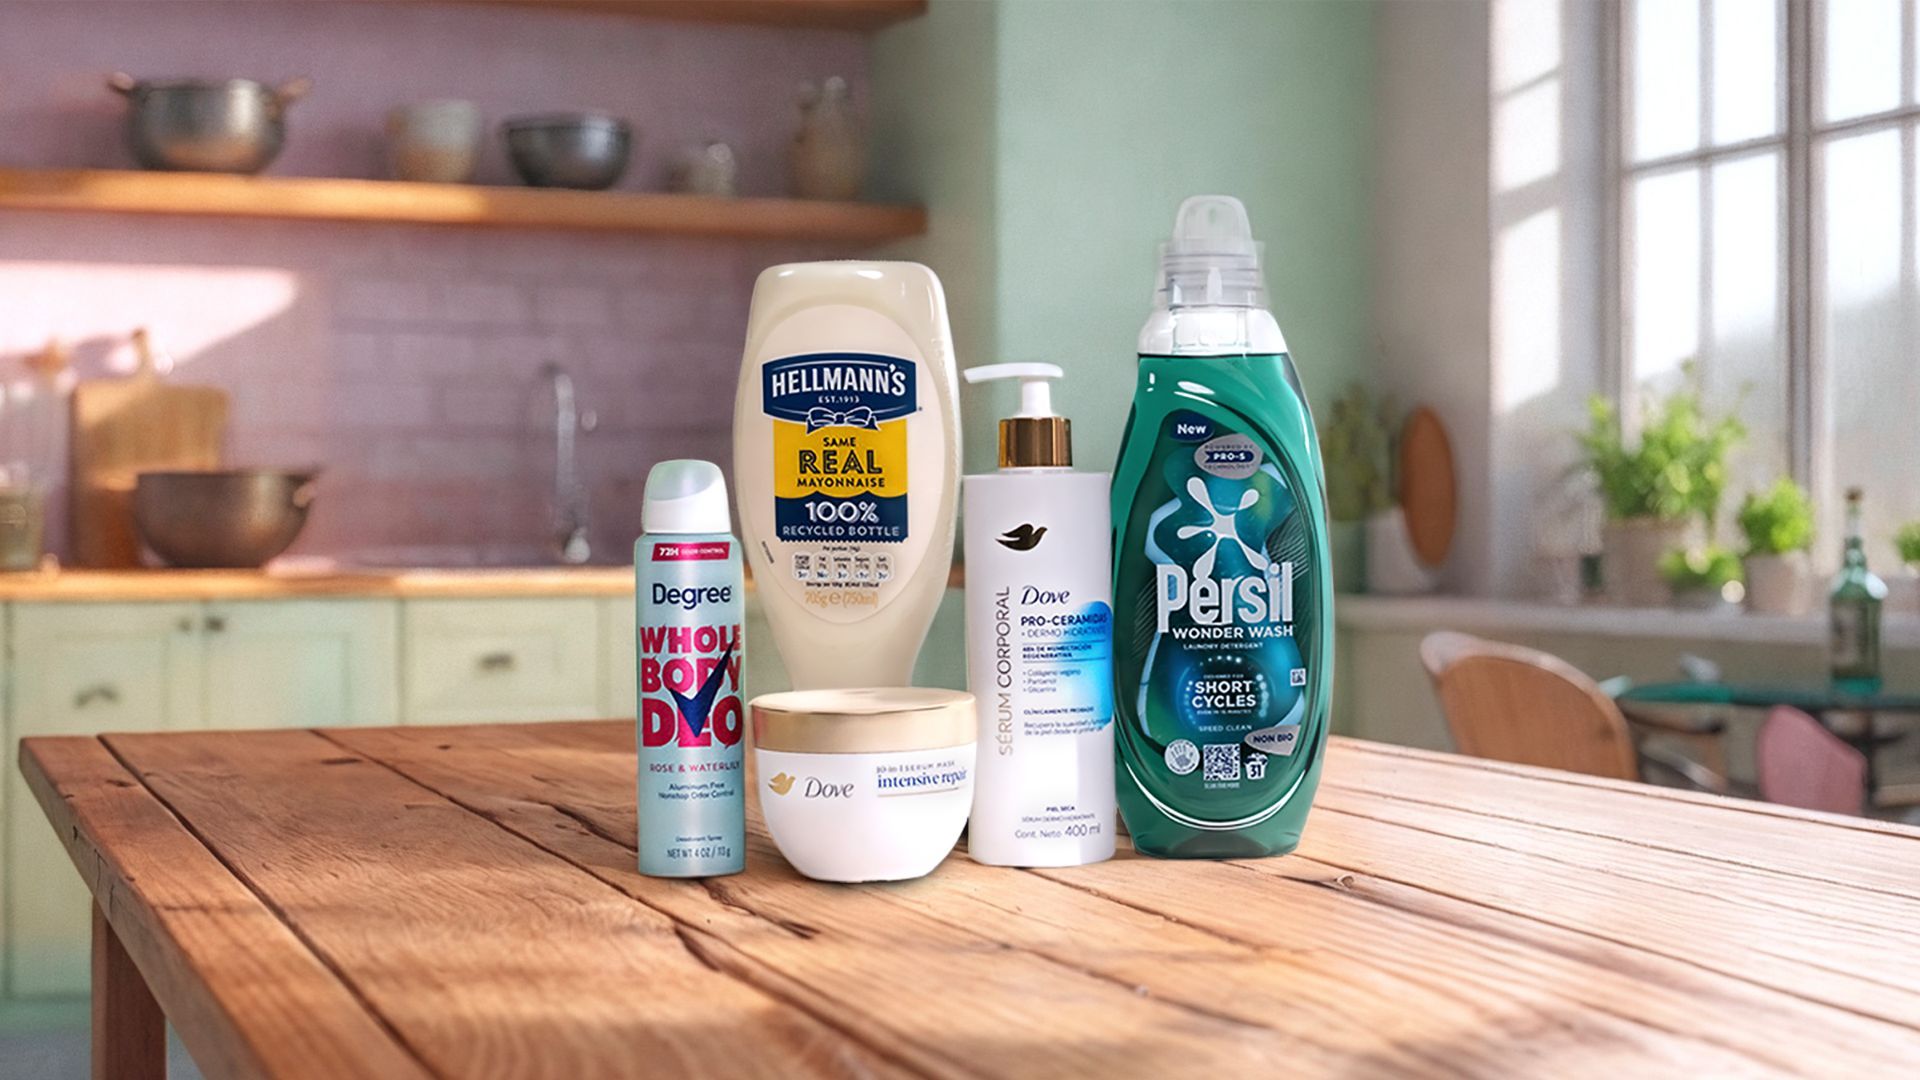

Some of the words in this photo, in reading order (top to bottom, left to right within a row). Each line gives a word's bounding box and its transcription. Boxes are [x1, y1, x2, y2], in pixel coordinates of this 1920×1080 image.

[772, 363, 906, 398] HELLMANN'S
[1176, 423, 1207, 435] New
[823, 437, 856, 447] SAME
[798, 450, 883, 475] REAL
[1213, 452, 1246, 461] PRO-S
[797, 477, 885, 488] MAYONNAISE
[805, 501, 880, 523] 100%
[782, 525, 845, 537] RECYCLED
[848, 525, 900, 537] BOTTLE
[659, 547, 679, 557] 72H
[652, 583, 732, 610] Degree
[1020, 585, 1071, 605] Dove
[1156, 561, 1294, 633] Persil
[640, 623, 742, 653] WHOLE
[996, 586, 1012, 688] CORPORAL
[1172, 626, 1244, 639] WONDER
[1248, 625, 1294, 638] WASH
[641, 655, 742, 693] BODY
[1195, 680, 1253, 694] SHORT
[1191, 694, 1257, 708] CYCLES
[642, 695, 744, 748] DEO
[995, 693, 1014, 757] SÉRUM
[1198, 724, 1224, 732] SPEED
[1253, 734, 1276, 743] NON
[1277, 733, 1294, 742] BIO
[649, 763, 674, 773] ROSE
[678, 763, 686, 773] &
[1250, 764, 1262, 778] 31
[804, 775, 855, 798] Dove
[878, 771, 940, 788] intensive
[1064, 823, 1088, 837] 400
[1089, 822, 1101, 835] ml
